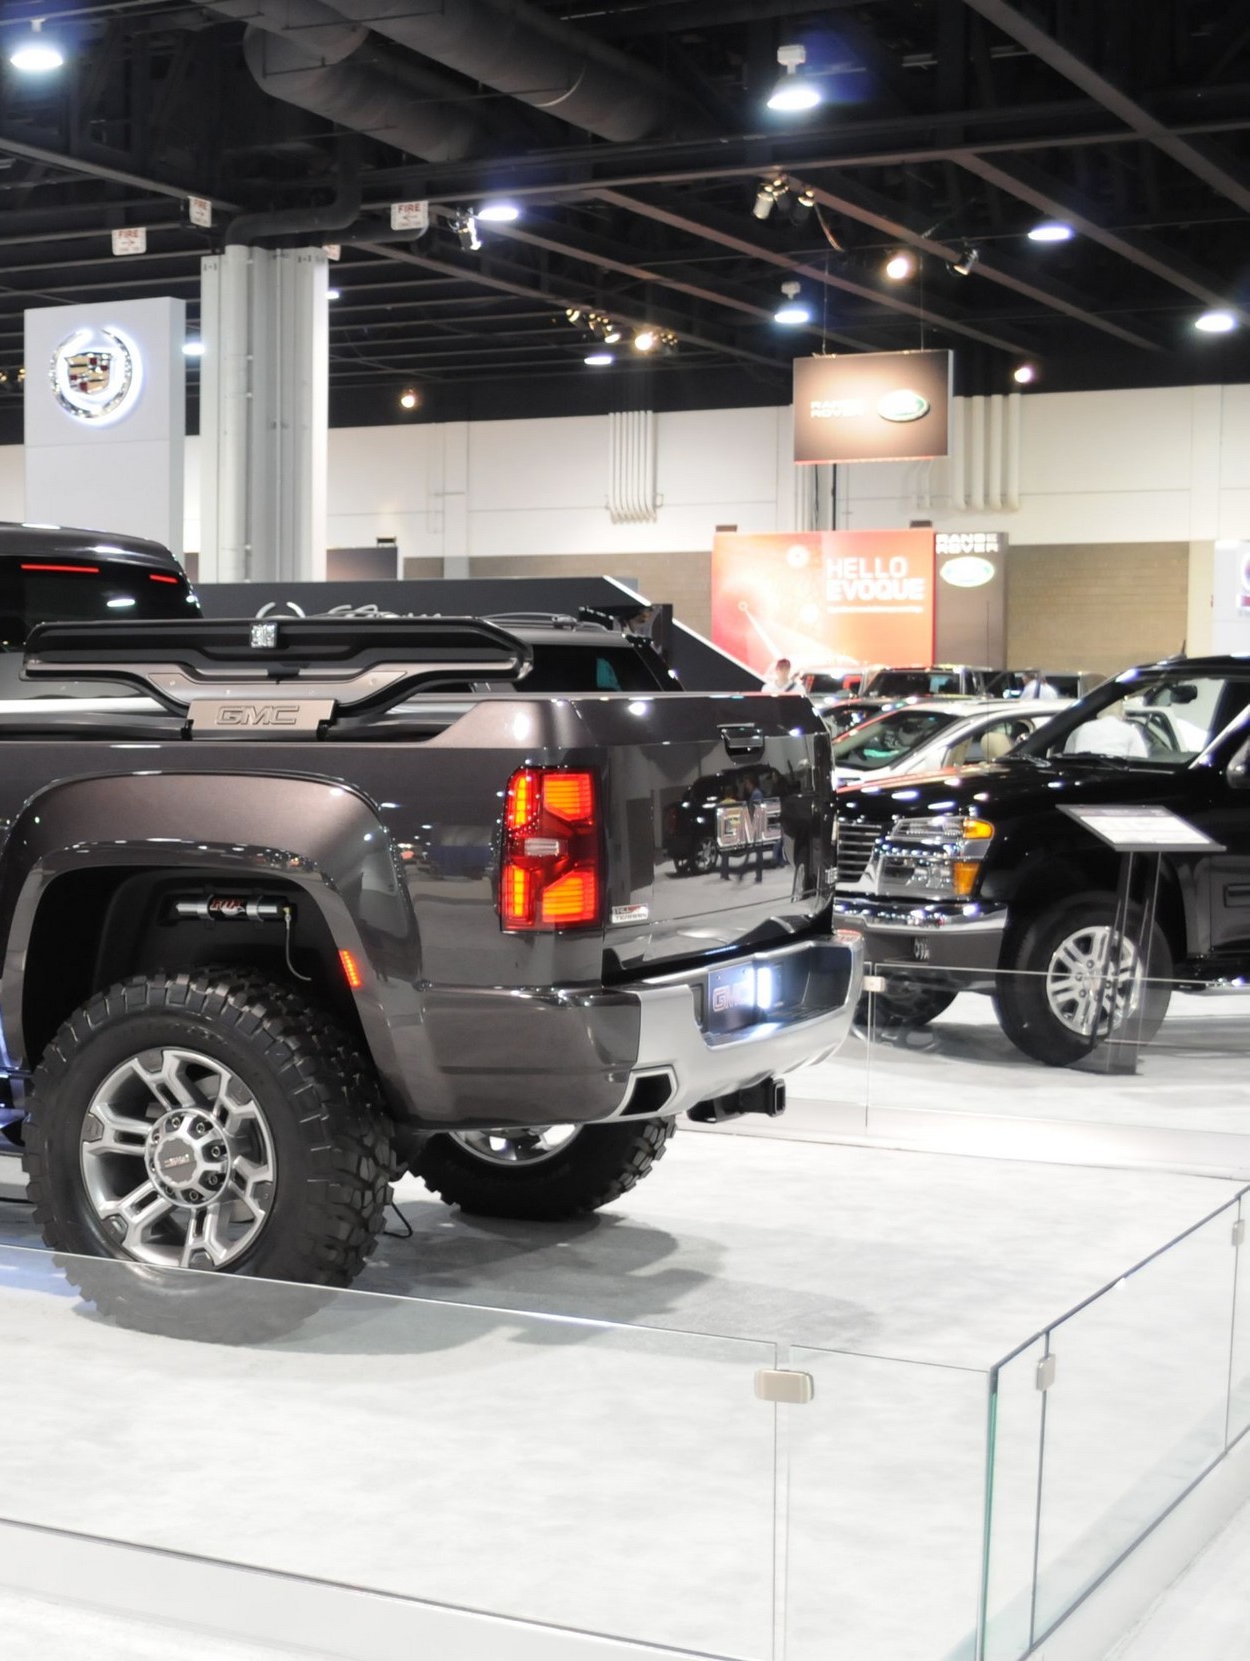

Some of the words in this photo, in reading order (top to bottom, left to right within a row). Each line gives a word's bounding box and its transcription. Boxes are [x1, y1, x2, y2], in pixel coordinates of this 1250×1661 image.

[397, 203, 421, 213] FIRE
[117, 229, 140, 239] FIRE
[935, 533, 998, 545] RANGE
[935, 542, 999, 555] ROVER
[826, 556, 908, 579] HELLO
[826, 578, 925, 601] EVOQUE
[216, 704, 301, 726] GMC
[717, 797, 782, 851] GMC
